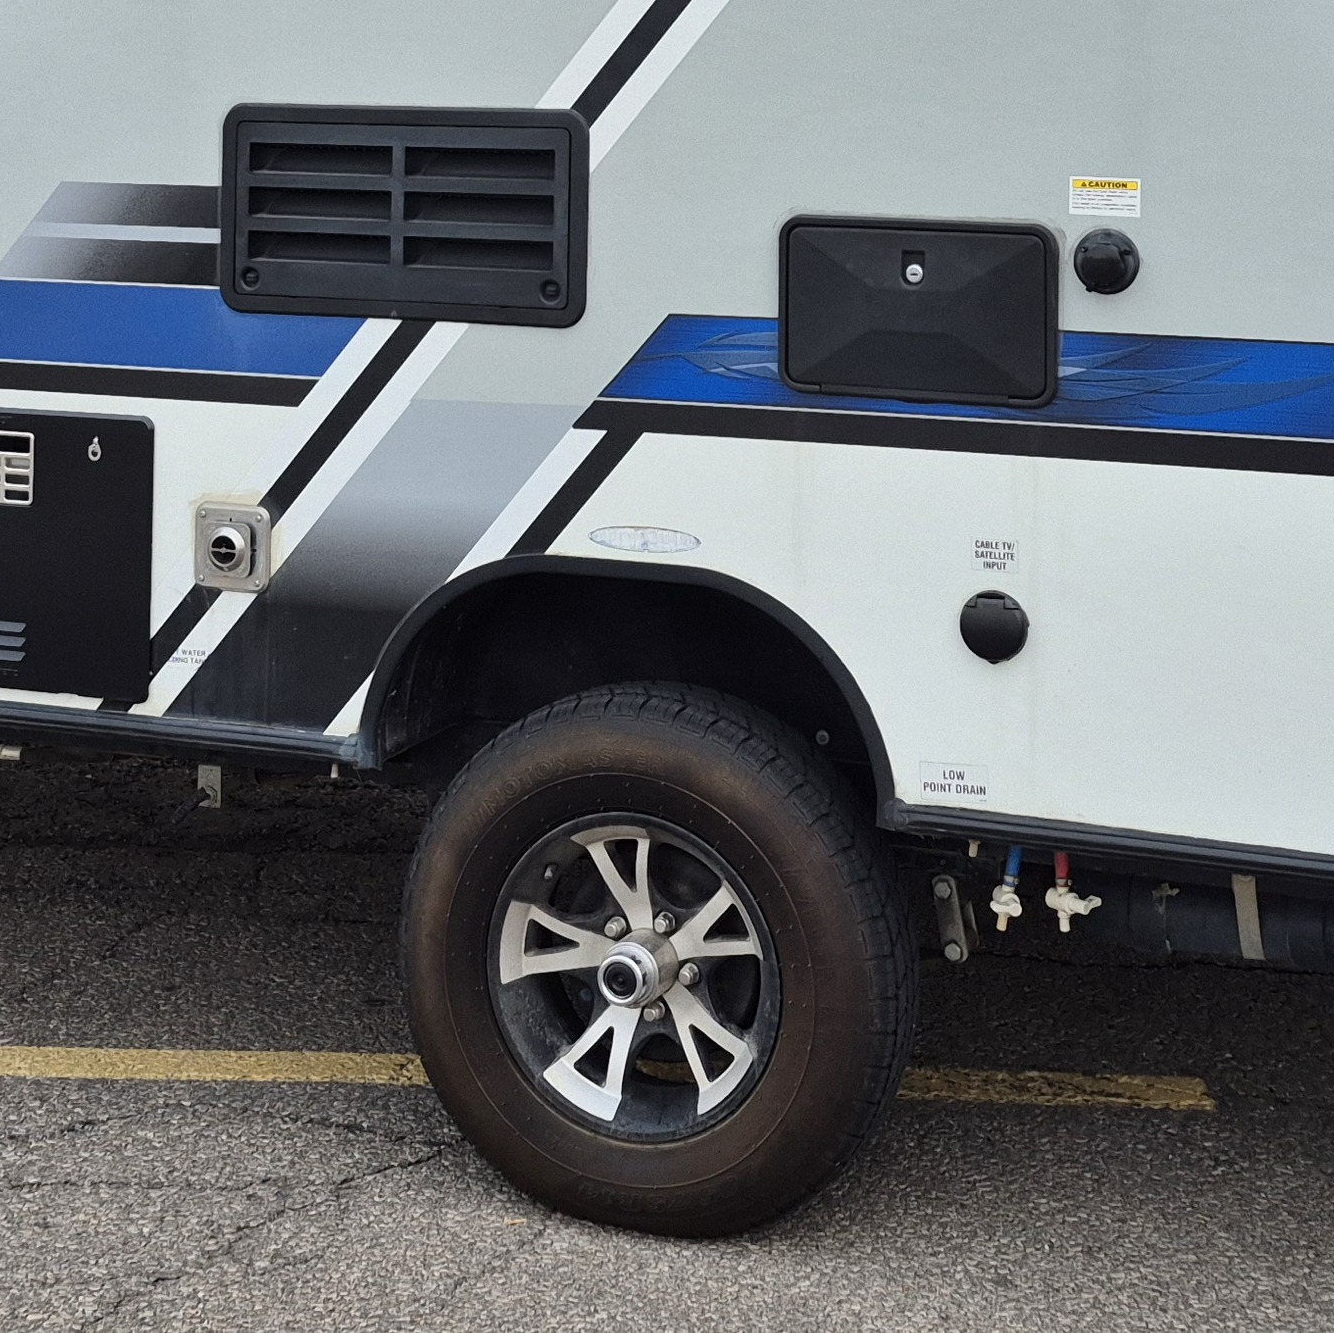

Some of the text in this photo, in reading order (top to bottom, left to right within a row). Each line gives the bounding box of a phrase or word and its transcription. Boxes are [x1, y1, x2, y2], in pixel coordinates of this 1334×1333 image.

[1088, 181, 1128, 189] CAUTION
[975, 539, 1015, 551] CABLE TV/
[974, 549, 1015, 561] SATELLITE
[983, 561, 1007, 570] INPUT
[181, 649, 206, 657] WATER
[943, 769, 965, 781] LOW
[923, 781, 986, 796] POINT DRAIN
